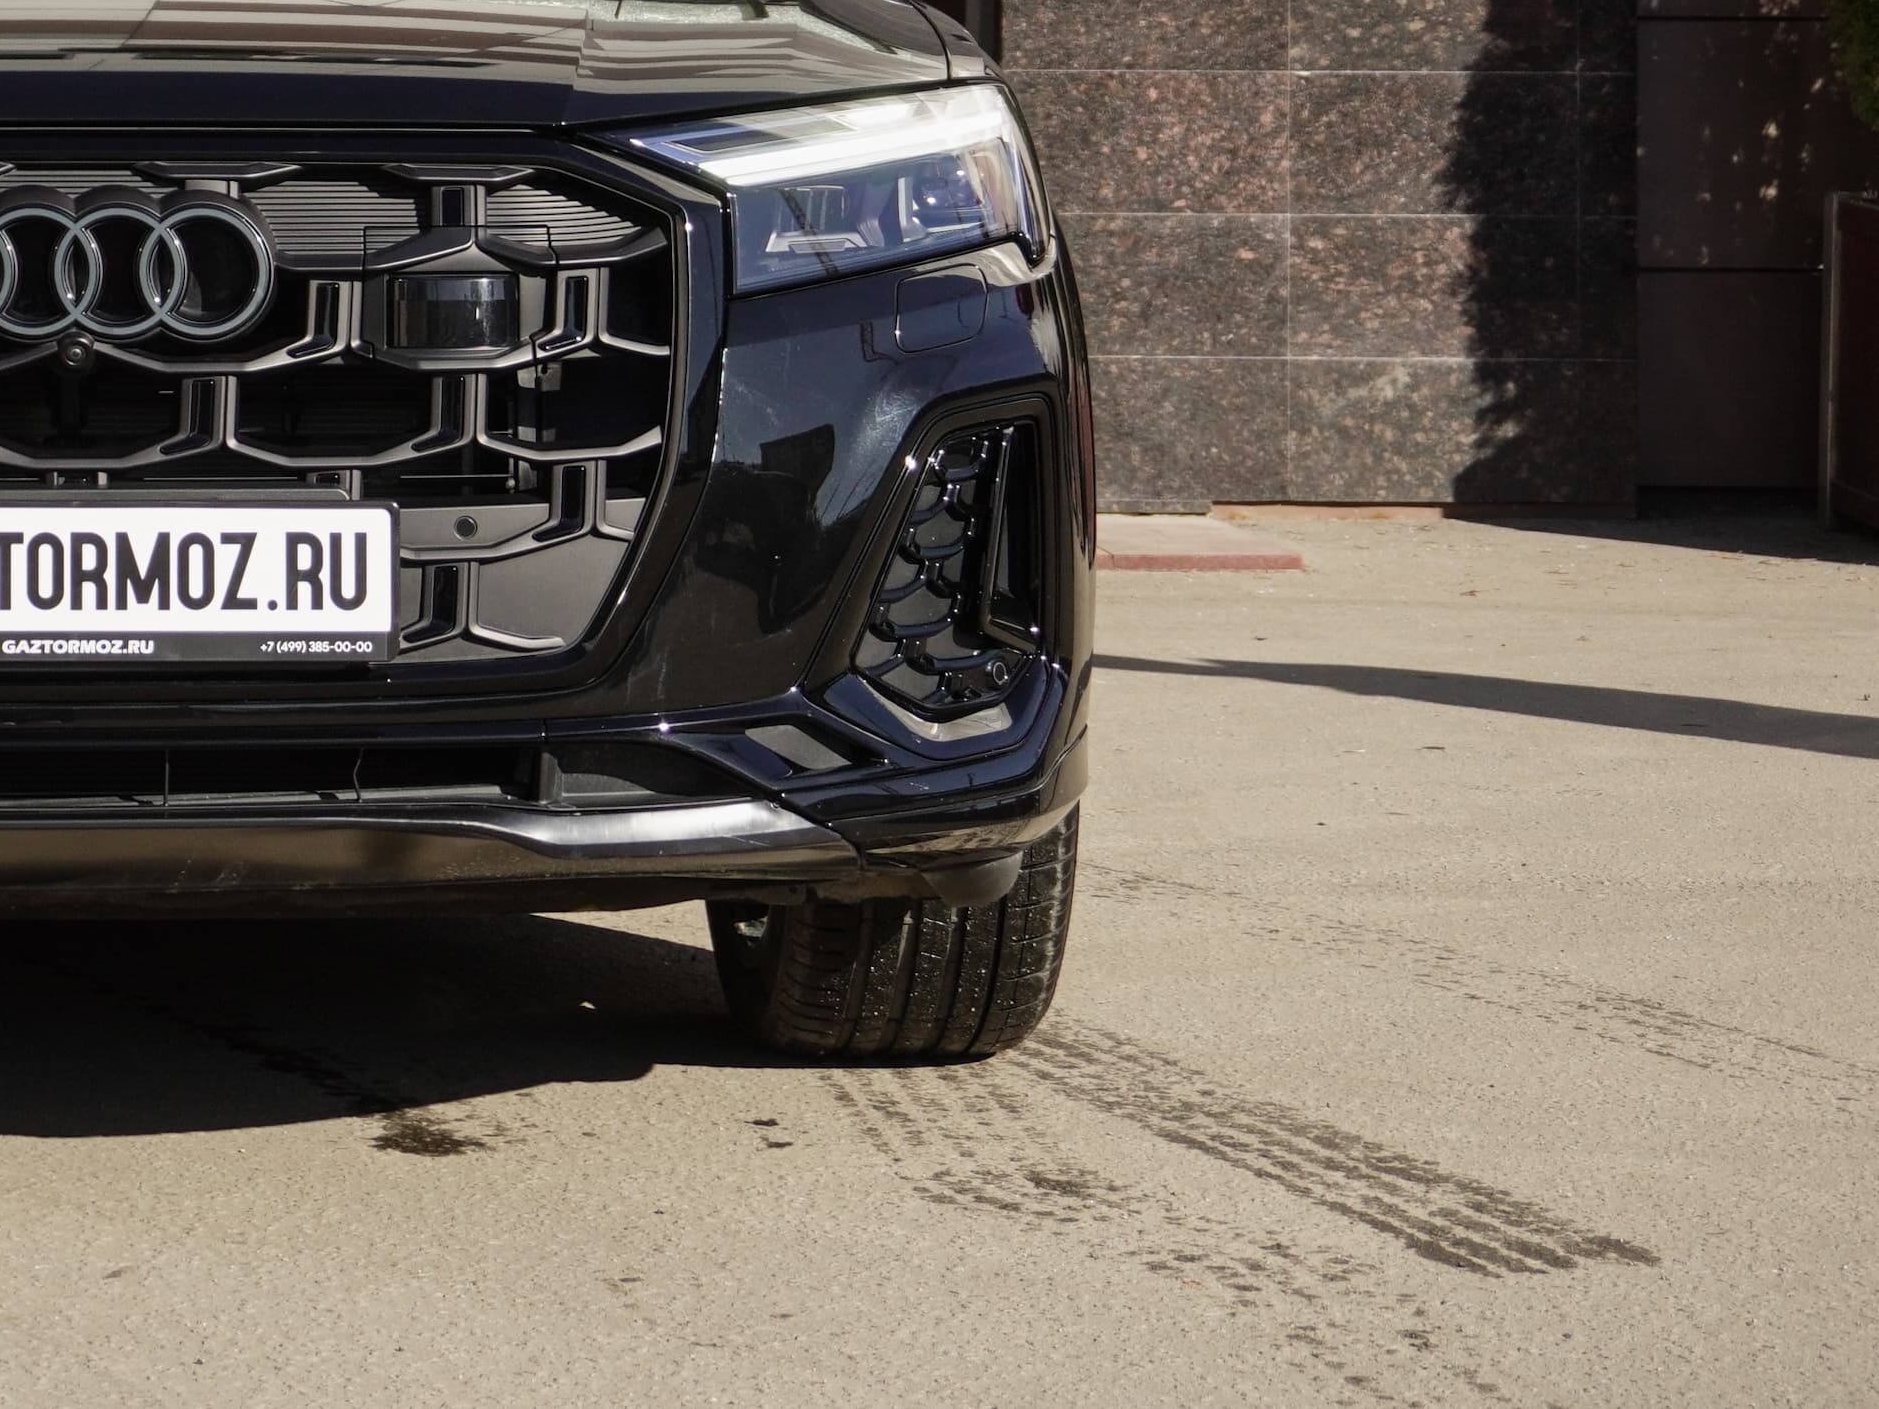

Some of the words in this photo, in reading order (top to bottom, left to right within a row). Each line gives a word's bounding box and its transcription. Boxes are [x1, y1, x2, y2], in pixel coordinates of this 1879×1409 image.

[1, 639, 155, 655] GAZTORMOZ.RU
[260, 641, 275, 652] +7
[276, 640, 306, 653] (499)
[308, 641, 373, 652] 385-00-00
